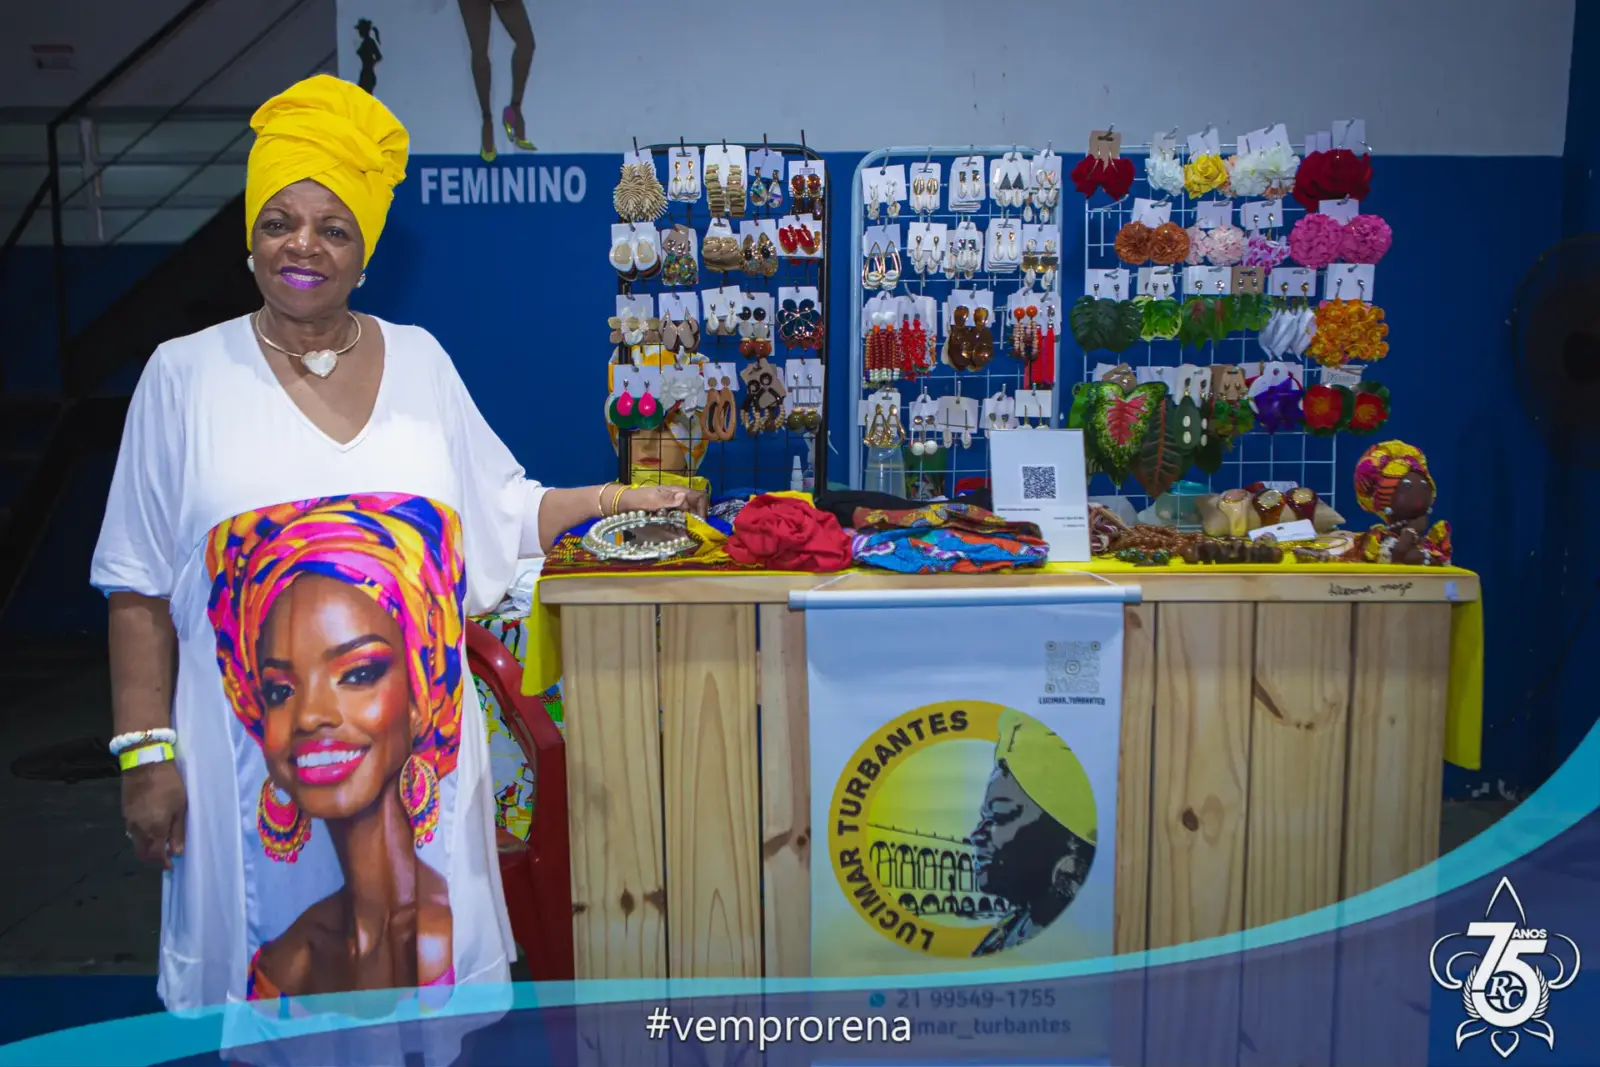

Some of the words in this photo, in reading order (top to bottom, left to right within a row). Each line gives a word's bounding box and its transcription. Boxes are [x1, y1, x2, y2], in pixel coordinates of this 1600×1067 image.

[420, 165, 587, 205] FEMININO
[837, 709, 969, 836] TURBANTES
[839, 847, 935, 951] LUCIMAR
[896, 988, 921, 1009] 21
[930, 987, 1057, 1009] 99549-1755
[883, 1016, 1072, 1040] imar_turbantes
